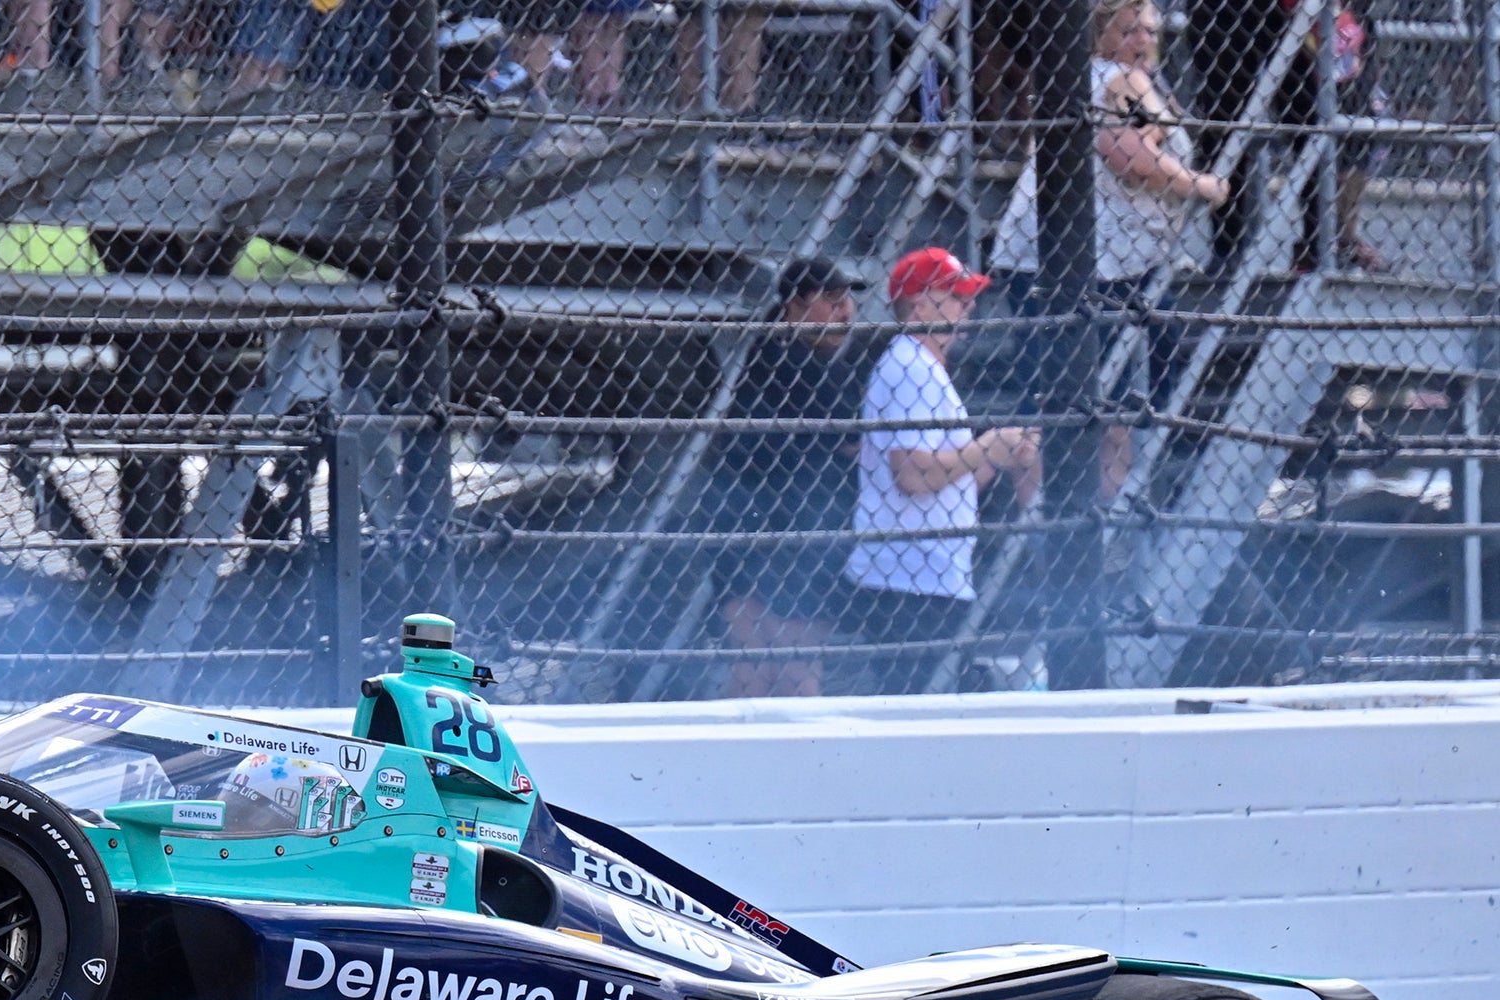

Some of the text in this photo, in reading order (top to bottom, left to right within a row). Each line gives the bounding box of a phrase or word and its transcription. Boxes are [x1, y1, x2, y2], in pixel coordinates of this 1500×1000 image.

[426, 689, 501, 762] 28
[223, 732, 287, 752] Delaware
[376, 784, 406, 794] INDYCAR
[179, 809, 217, 821] SIEMENS
[479, 825, 520, 843] Ericsson
[41, 822, 79, 862] INDY
[73, 863, 96, 904] 500
[728, 900, 790, 946] HRC
